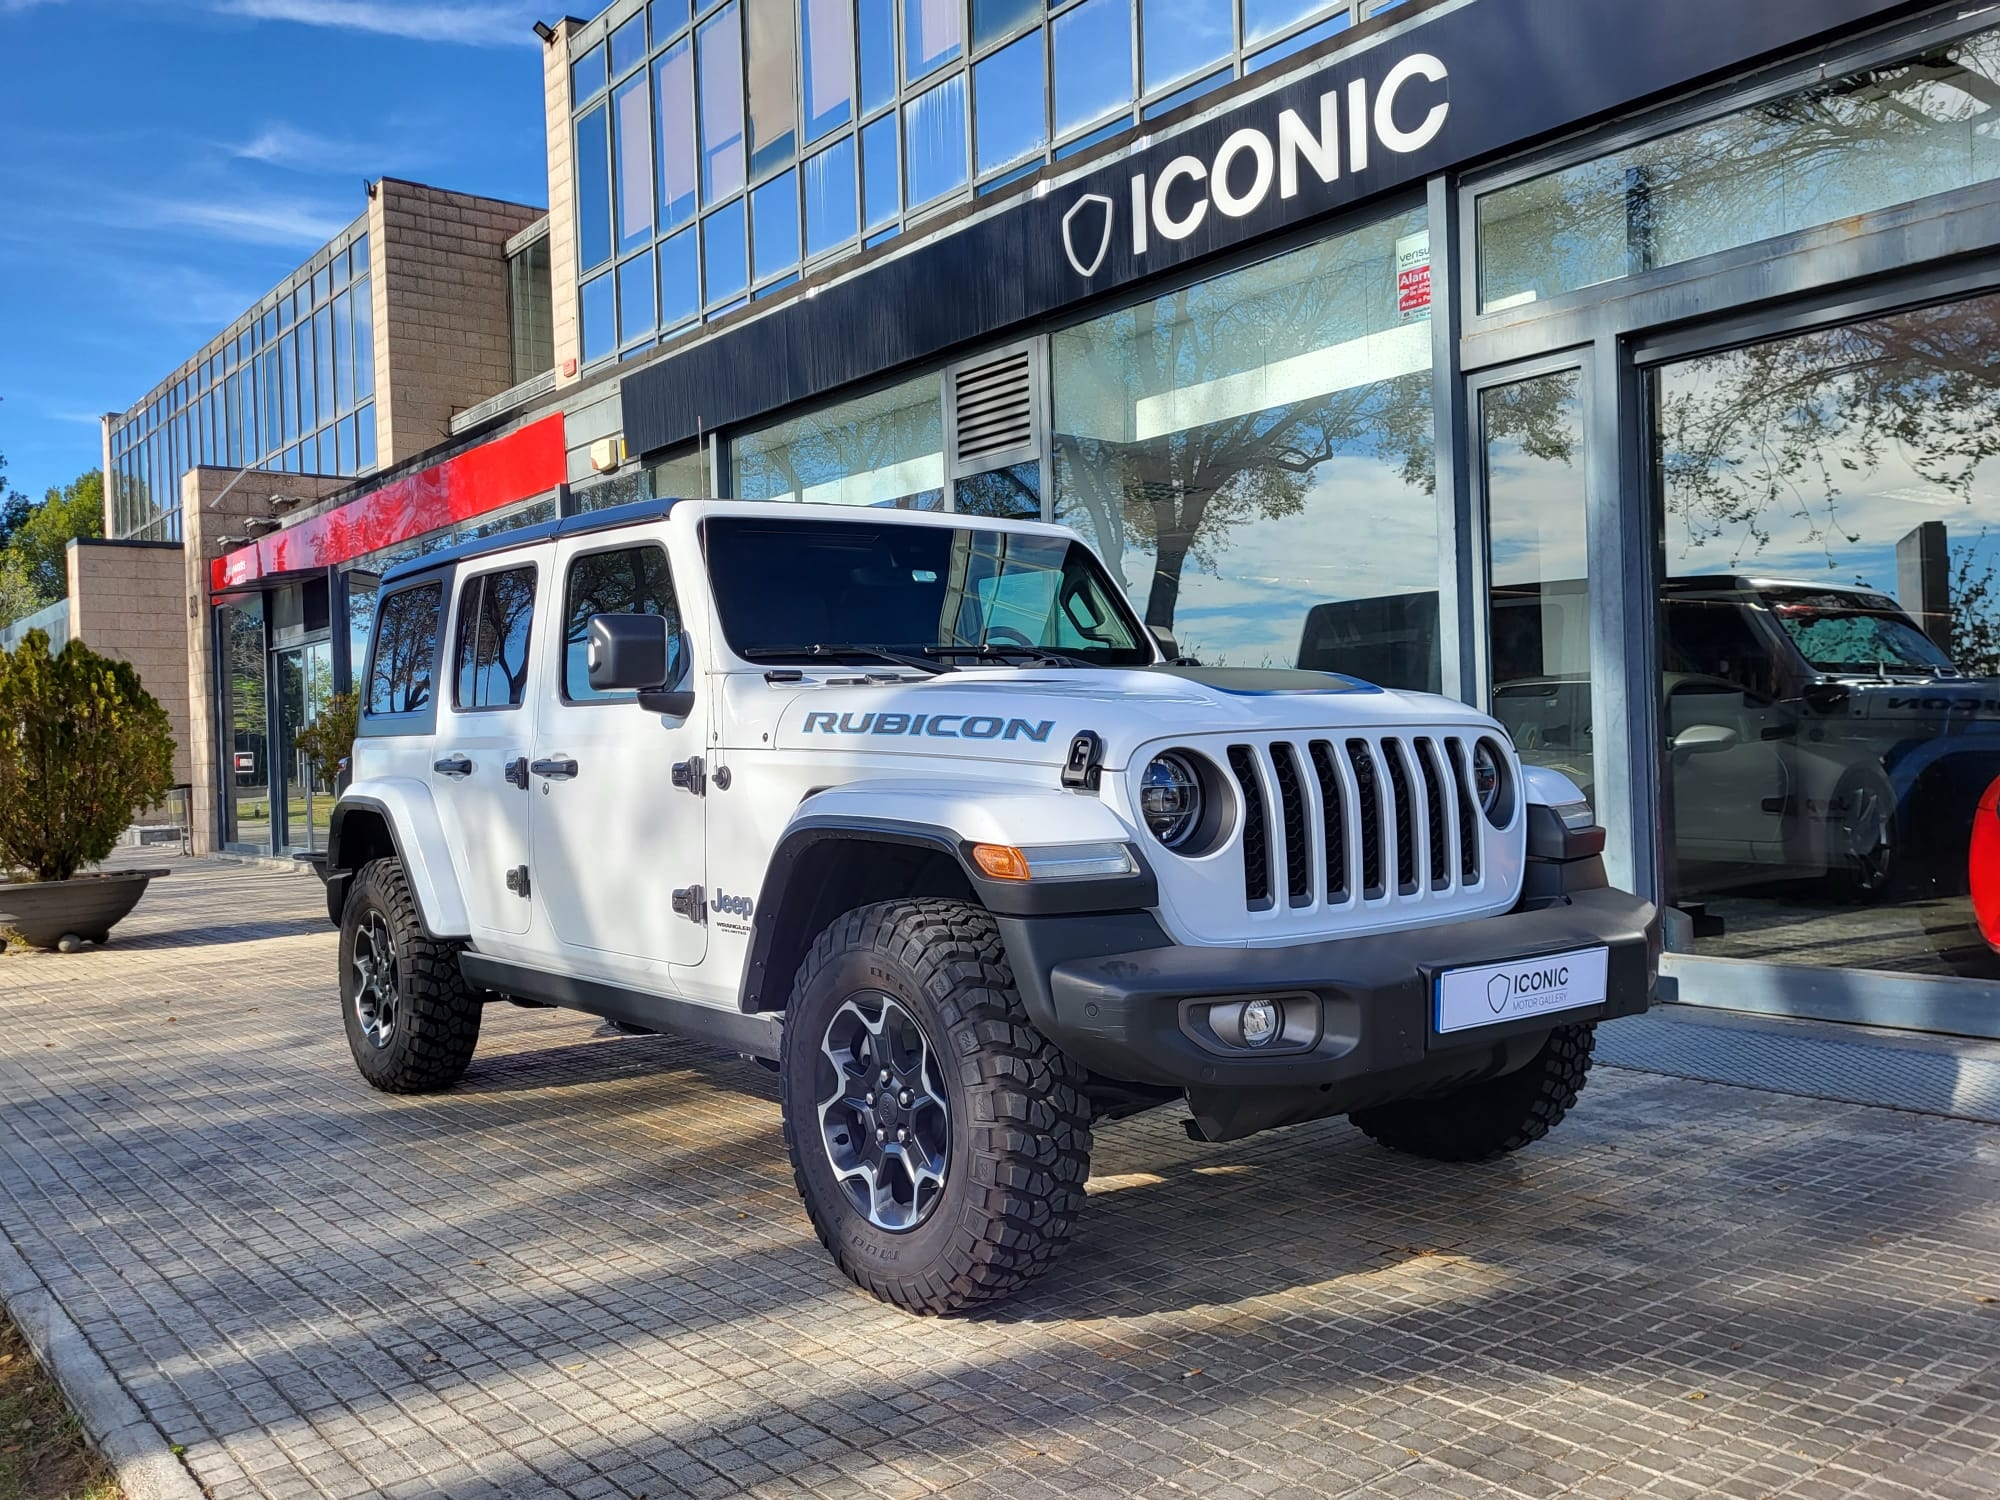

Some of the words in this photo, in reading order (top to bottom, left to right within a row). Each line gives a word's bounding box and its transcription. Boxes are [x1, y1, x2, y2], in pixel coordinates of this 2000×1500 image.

[1131, 53, 1450, 255] ICONIC
[803, 712, 1056, 743] RUBICON
[711, 888, 754, 921] Jeep
[716, 921, 751, 931] WRANGLER
[1514, 967, 1568, 994] ICONIC
[1513, 998, 1538, 1010] MOTOR
[1538, 993, 1567, 1006] GALLERY
